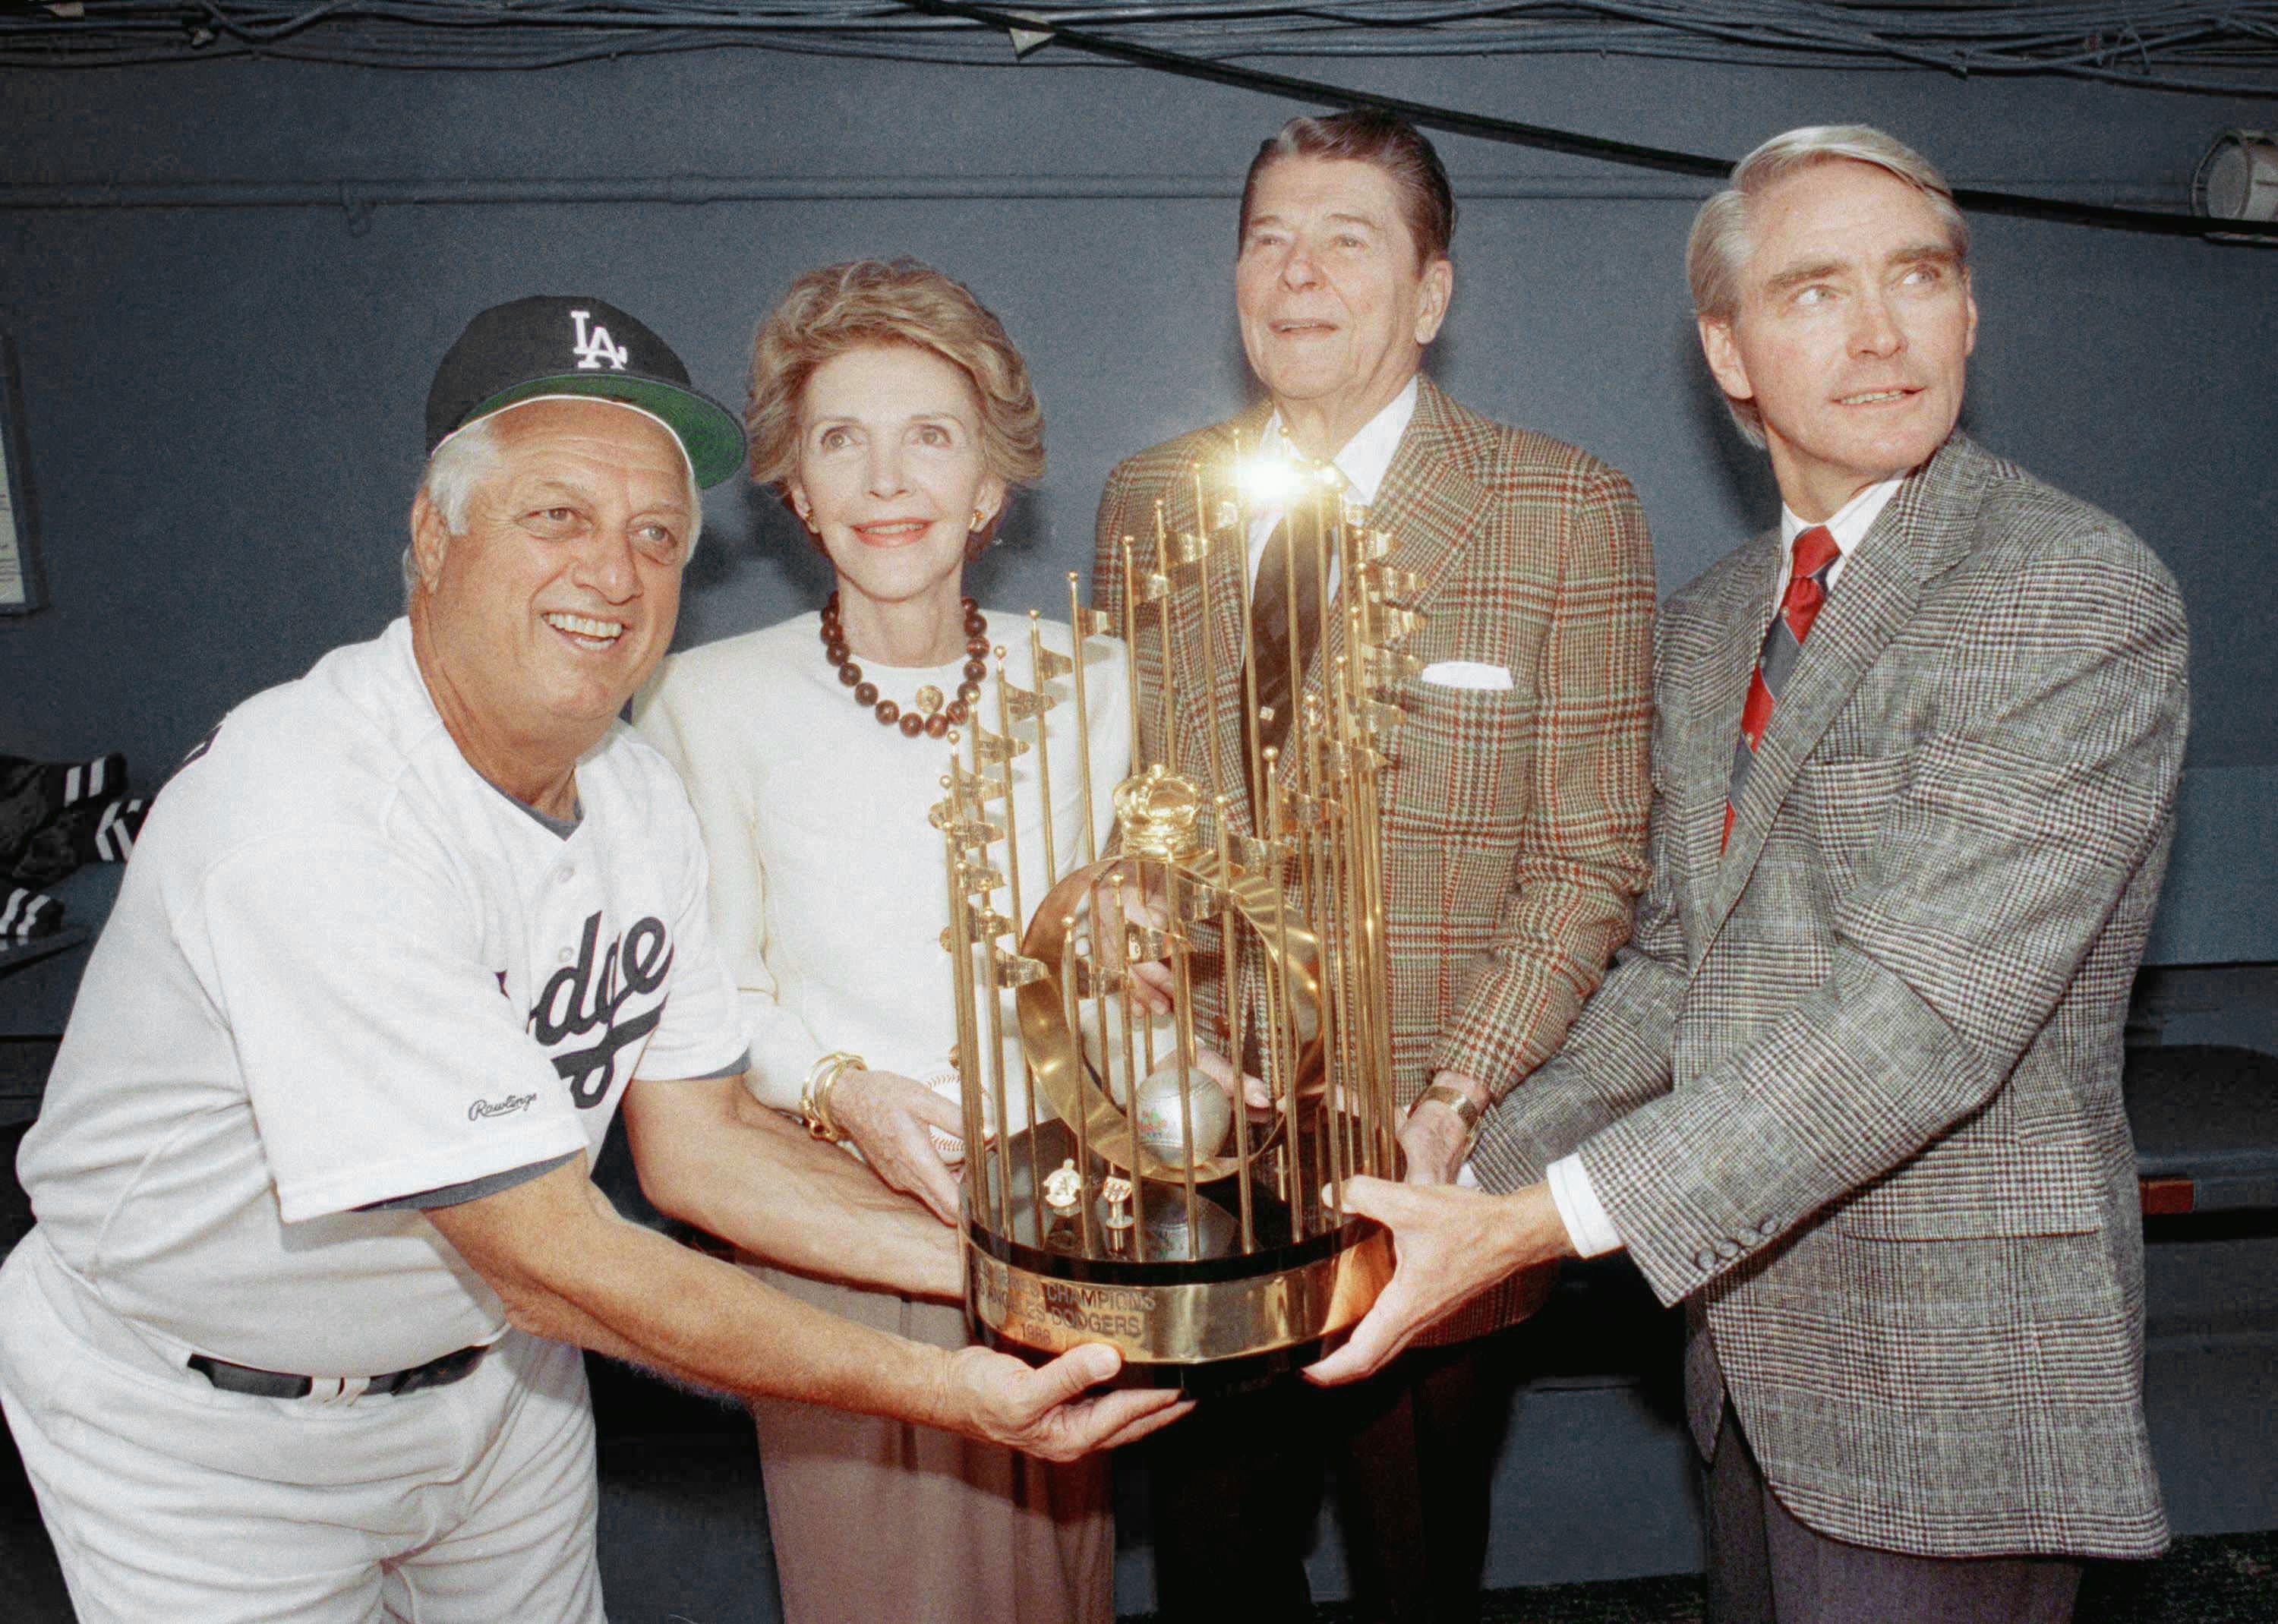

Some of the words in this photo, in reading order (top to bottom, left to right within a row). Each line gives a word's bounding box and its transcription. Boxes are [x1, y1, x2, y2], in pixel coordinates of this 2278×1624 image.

[570, 310, 628, 371] LA
[469, 1093, 537, 1121] Rawlings
[1046, 1282, 1156, 1310] CHAMPIONS
[1051, 1306, 1141, 1337] DODGERS
